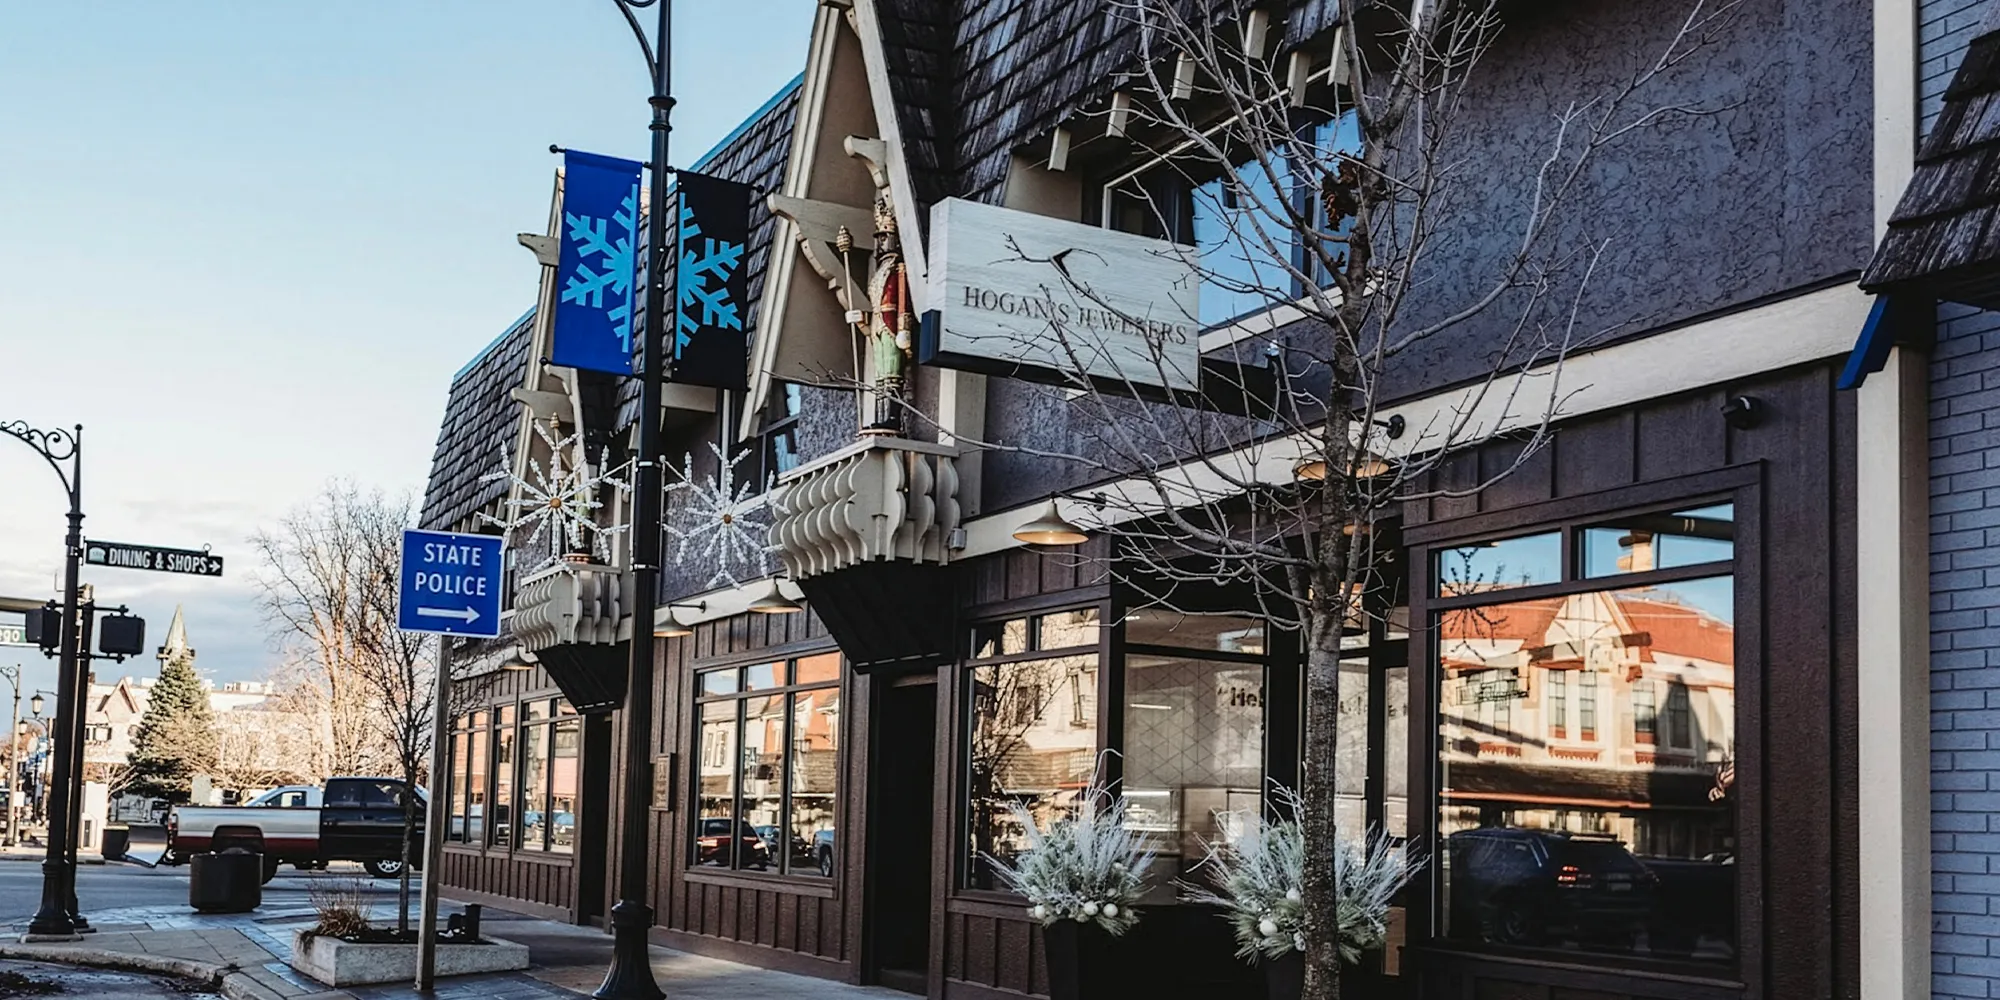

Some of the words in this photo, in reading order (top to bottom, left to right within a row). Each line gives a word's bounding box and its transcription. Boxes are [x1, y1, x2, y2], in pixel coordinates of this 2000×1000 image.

[963, 285, 1069, 324] HOGAN'S
[1076, 307, 1187, 345] JEWELERS
[109, 547, 151, 568] DINING
[155, 552, 164, 569] &
[167, 553, 208, 573] SHOPS
[424, 542, 482, 566] STATE
[415, 571, 487, 596] POLICE
